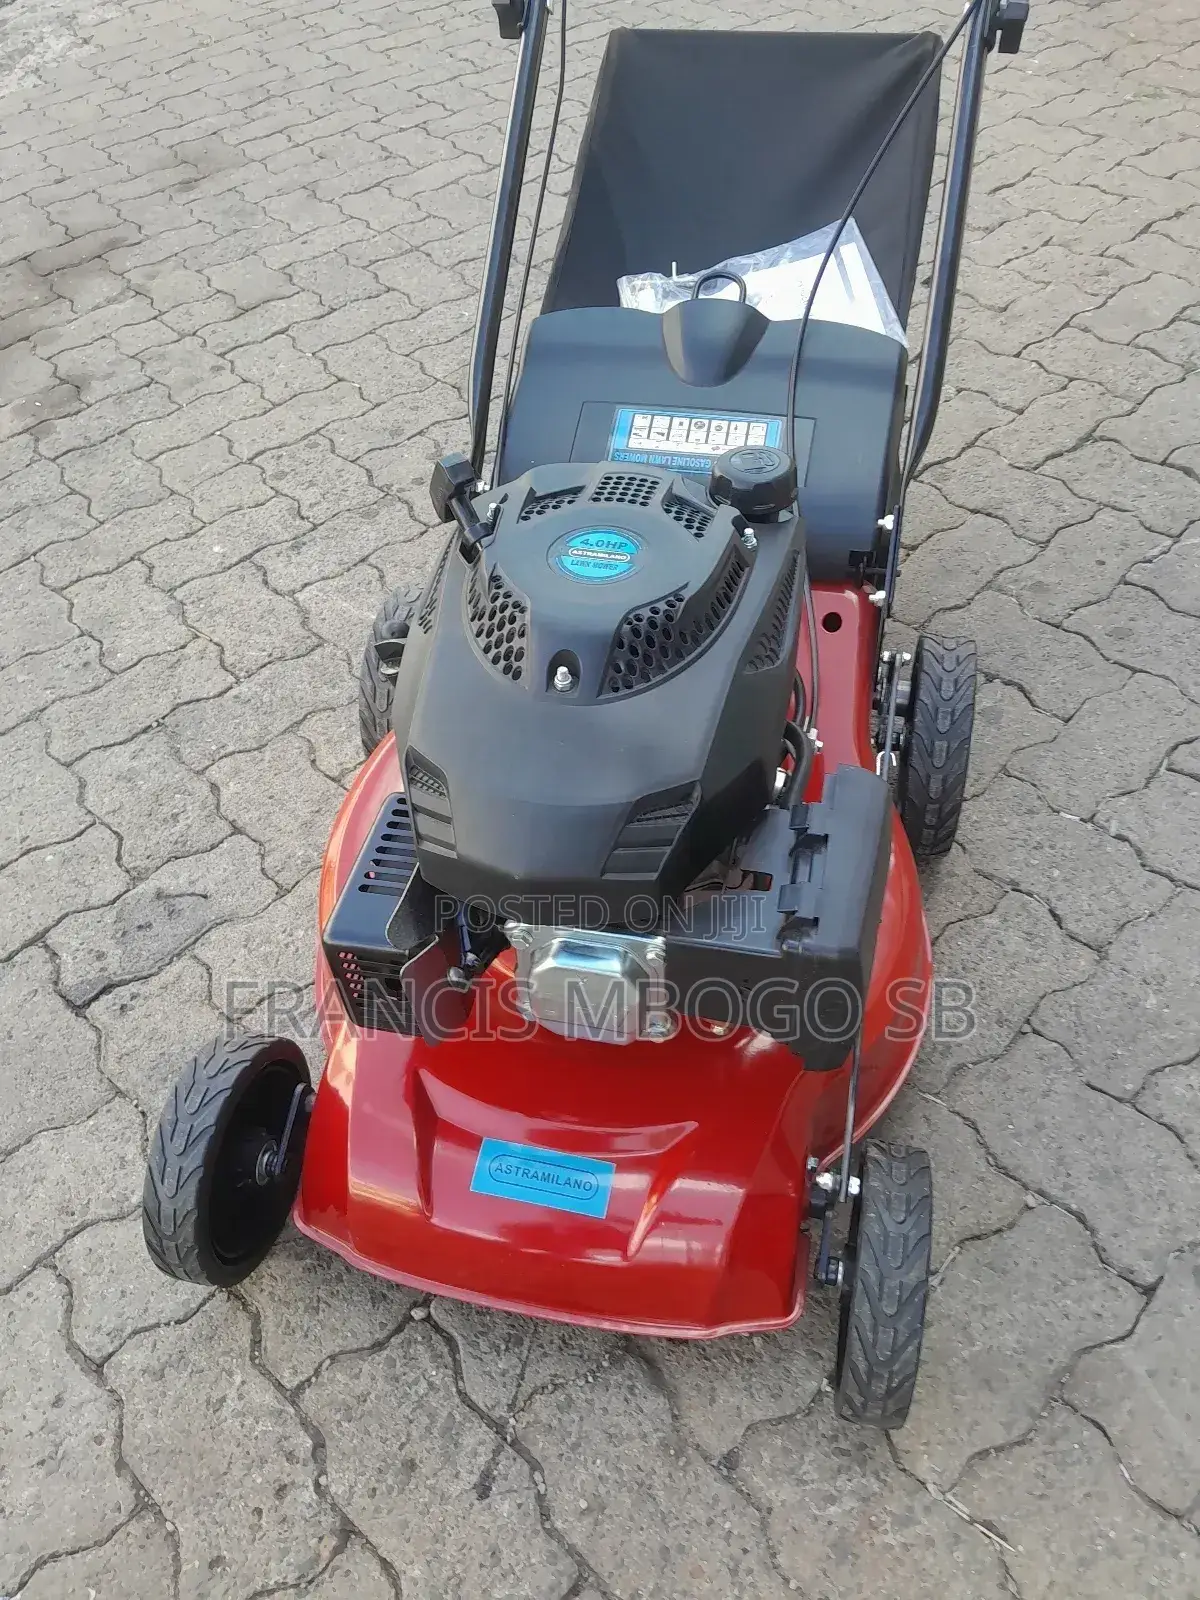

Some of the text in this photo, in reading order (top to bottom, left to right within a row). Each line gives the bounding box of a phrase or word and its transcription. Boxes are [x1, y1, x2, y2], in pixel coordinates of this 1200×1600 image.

[614, 451, 712, 468] GASOLINE LAWN MOWERS
[580, 538, 628, 550] 4.0HP
[572, 549, 627, 560] ASTRAMILANO
[571, 559, 619, 571] LAWN MOWER
[494, 1162, 593, 1192] ASTRAMILANO
